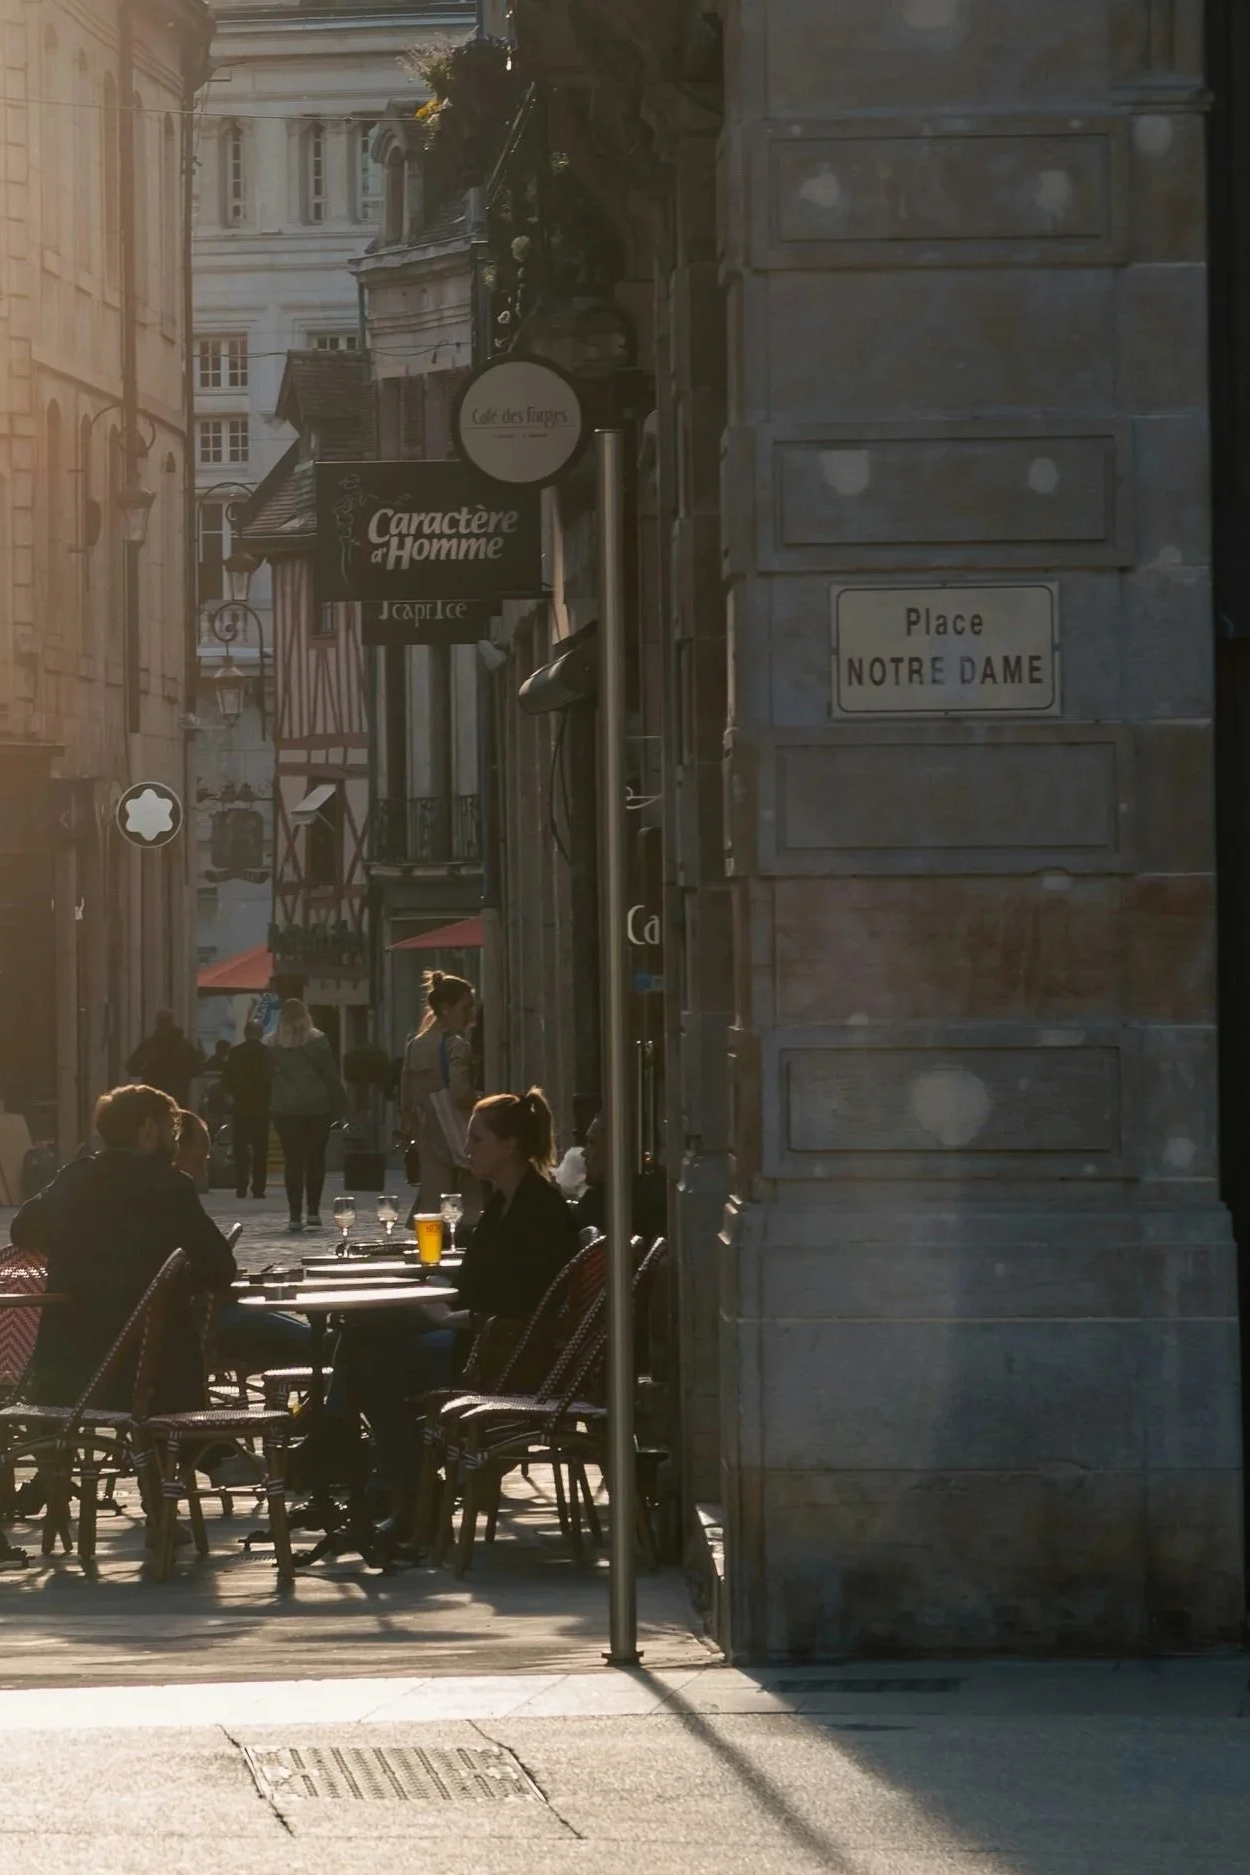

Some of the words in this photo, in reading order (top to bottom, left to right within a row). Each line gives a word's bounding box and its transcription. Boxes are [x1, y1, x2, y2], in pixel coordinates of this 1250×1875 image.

[502, 407, 524, 424] des
[367, 504, 519, 544] Caractère
[905, 606, 985, 637] Place
[846, 655, 947, 688] NOTRE
[959, 654, 1044, 686] DAME
